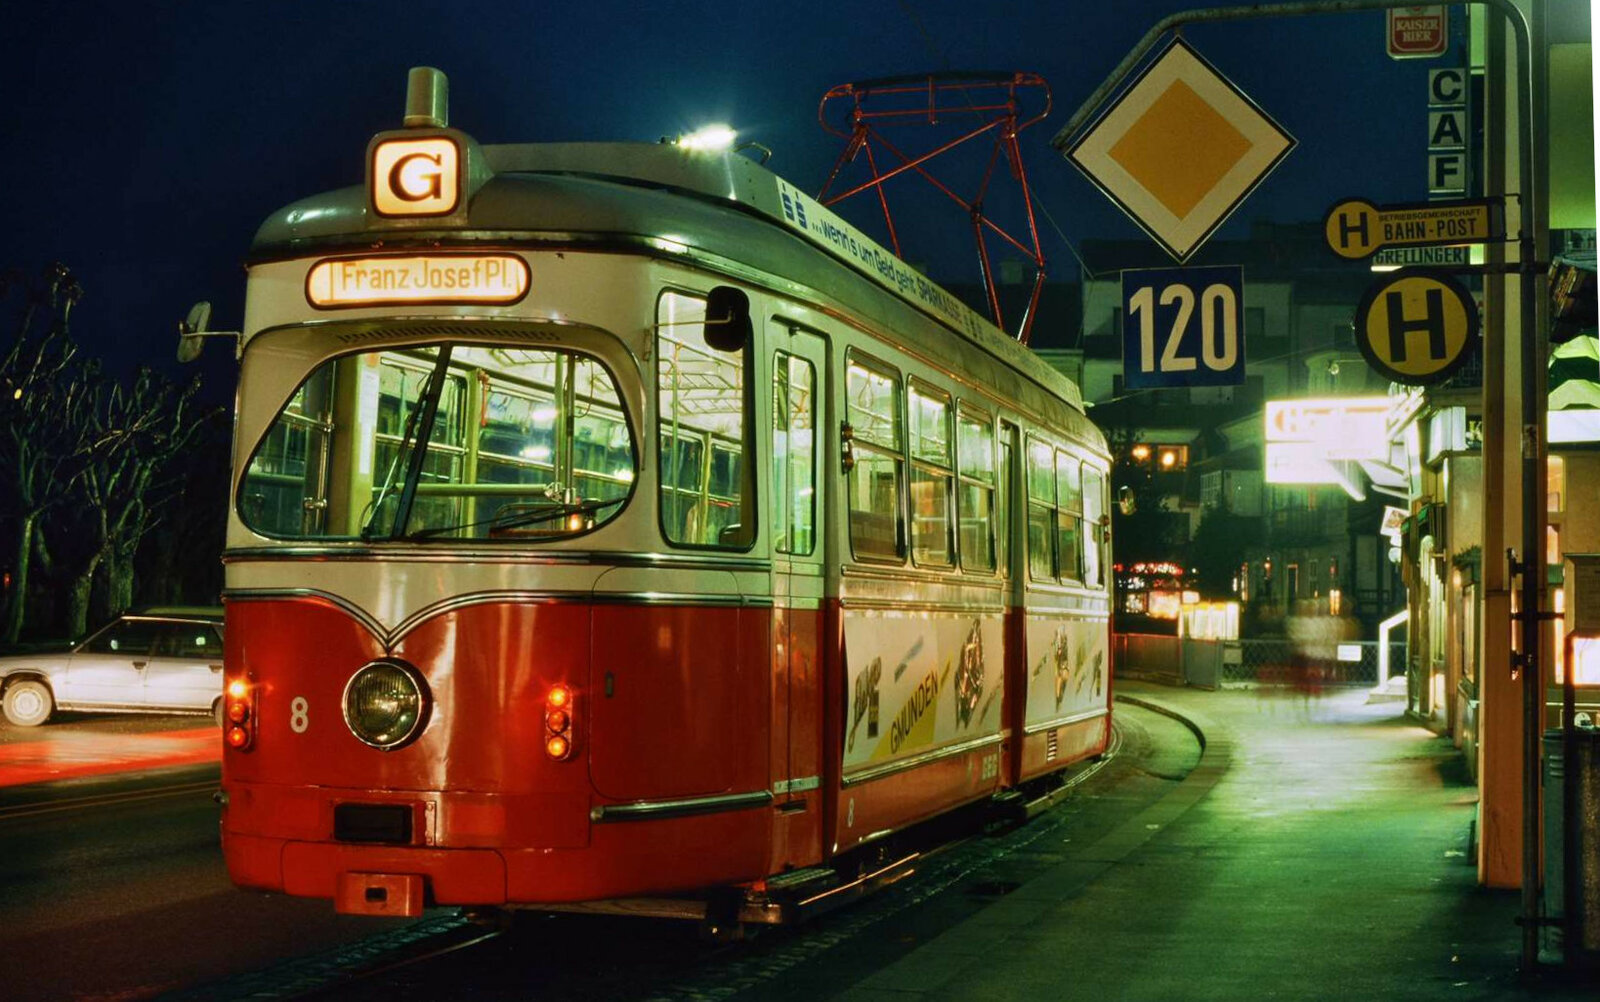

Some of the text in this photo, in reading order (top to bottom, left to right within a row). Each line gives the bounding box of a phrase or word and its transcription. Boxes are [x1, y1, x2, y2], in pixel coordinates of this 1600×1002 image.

[1396, 19, 1438, 31] KAISER
[1402, 31, 1432, 42] BIER
[1432, 70, 1462, 188] CAF
[388, 153, 442, 202] G
[1339, 212, 1369, 248] H
[1378, 208, 1481, 222] BETRIEBSGEMEINSCHAFT
[341, 259, 513, 290] Franz Josef Pl.
[858, 243, 876, 269] um
[874, 249, 896, 282] Geld
[1129, 283, 1237, 372] 120
[1385, 288, 1447, 363] H
[291, 696, 308, 733] 8
[890, 670, 938, 754] GMUNDEN
[847, 797, 855, 828] 8
